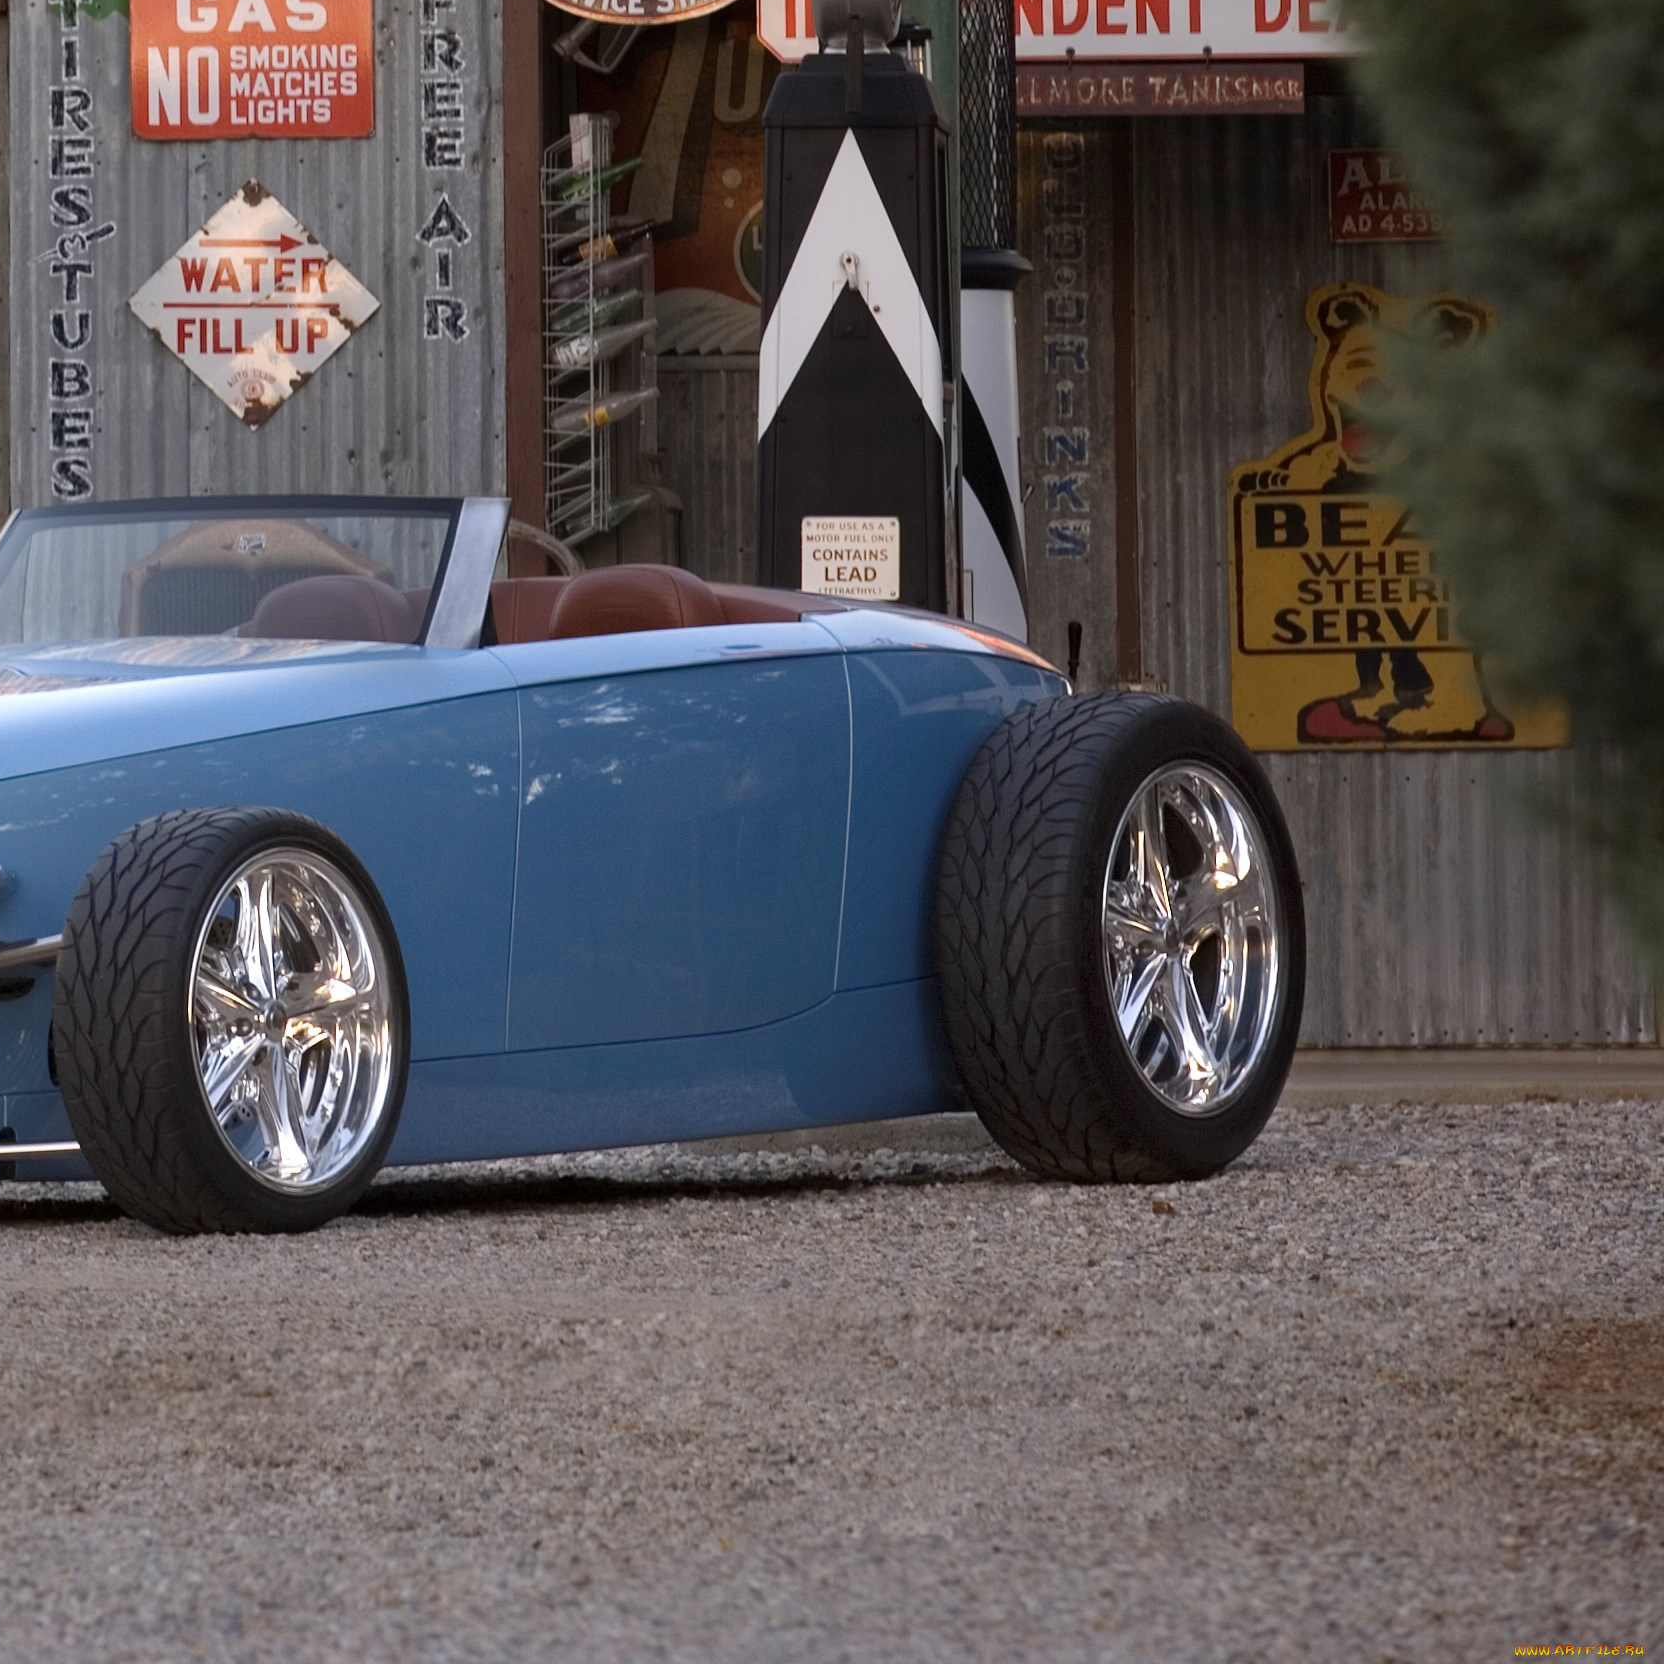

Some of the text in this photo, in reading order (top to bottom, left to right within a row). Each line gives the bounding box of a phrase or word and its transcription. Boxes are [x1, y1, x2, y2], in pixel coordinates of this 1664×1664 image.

[230, 43, 357, 70] SMOKING
[147, 45, 220, 126] NO
[230, 71, 357, 97] MATCHES
[230, 99, 331, 124] LIGHTS
[1341, 214, 1373, 234] AD
[179, 257, 329, 293] WATER
[416, 192, 472, 343] AIR
[177, 318, 329, 354] FILL UP
[48, 262, 95, 500] TUBES
[226, 369, 278, 389] AUTO CLUB
[806, 534, 895, 542] MOTOR FUEL ONLY
[816, 522, 885, 530] FOR USE AS A
[812, 549, 888, 561] CONTAINS
[824, 566, 877, 582] LEAD
